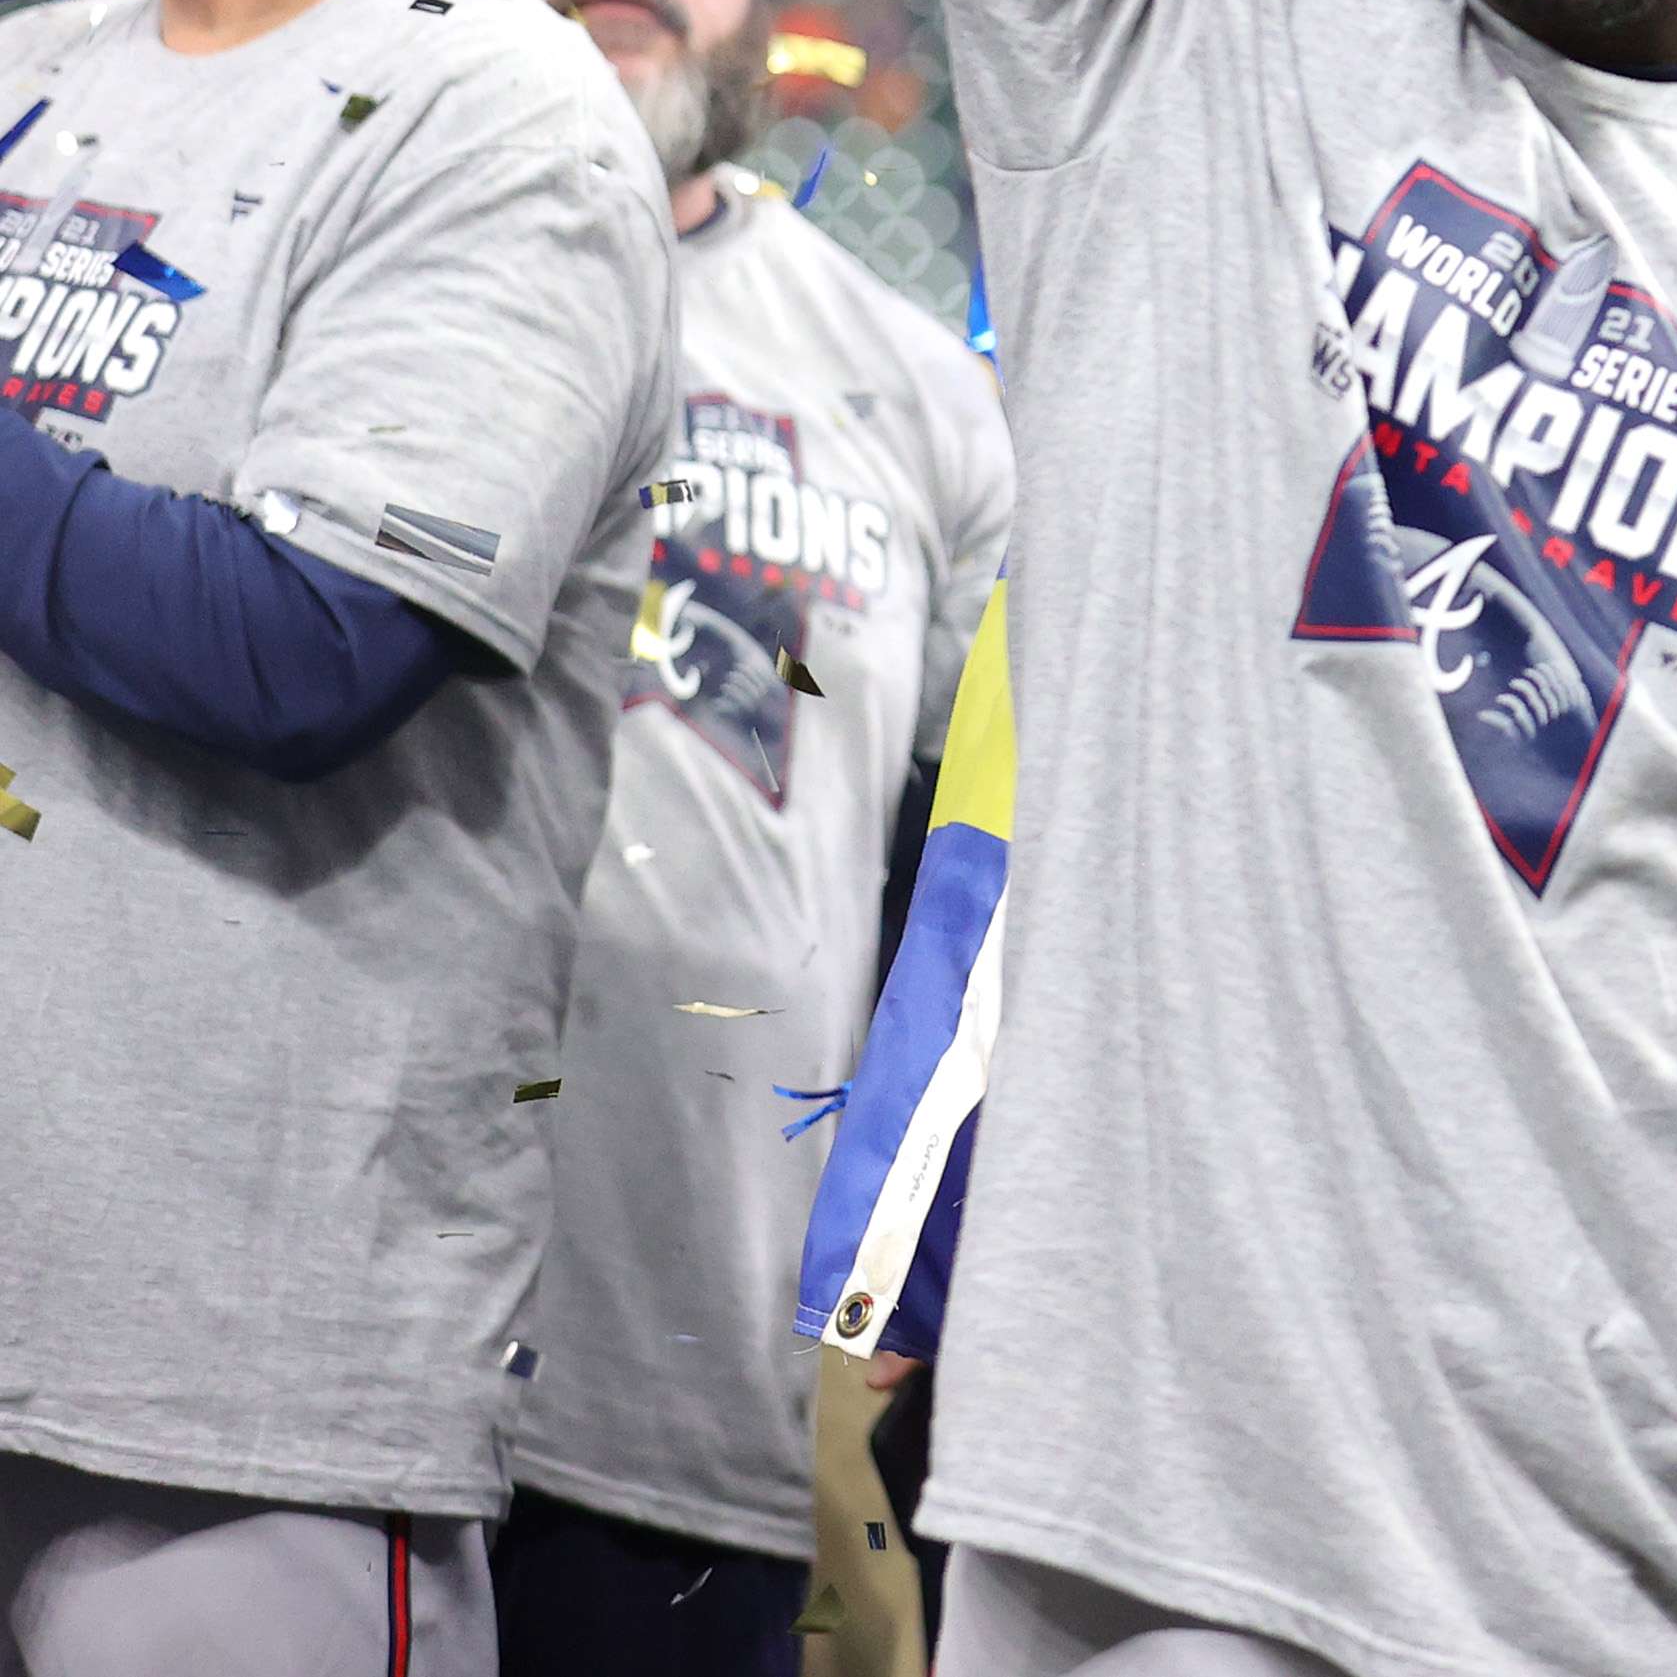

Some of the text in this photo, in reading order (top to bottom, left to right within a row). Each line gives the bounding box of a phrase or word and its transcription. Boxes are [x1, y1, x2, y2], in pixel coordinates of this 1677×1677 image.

[1384, 213, 1524, 338] WORLD
[1481, 231, 1655, 353] 20 21
